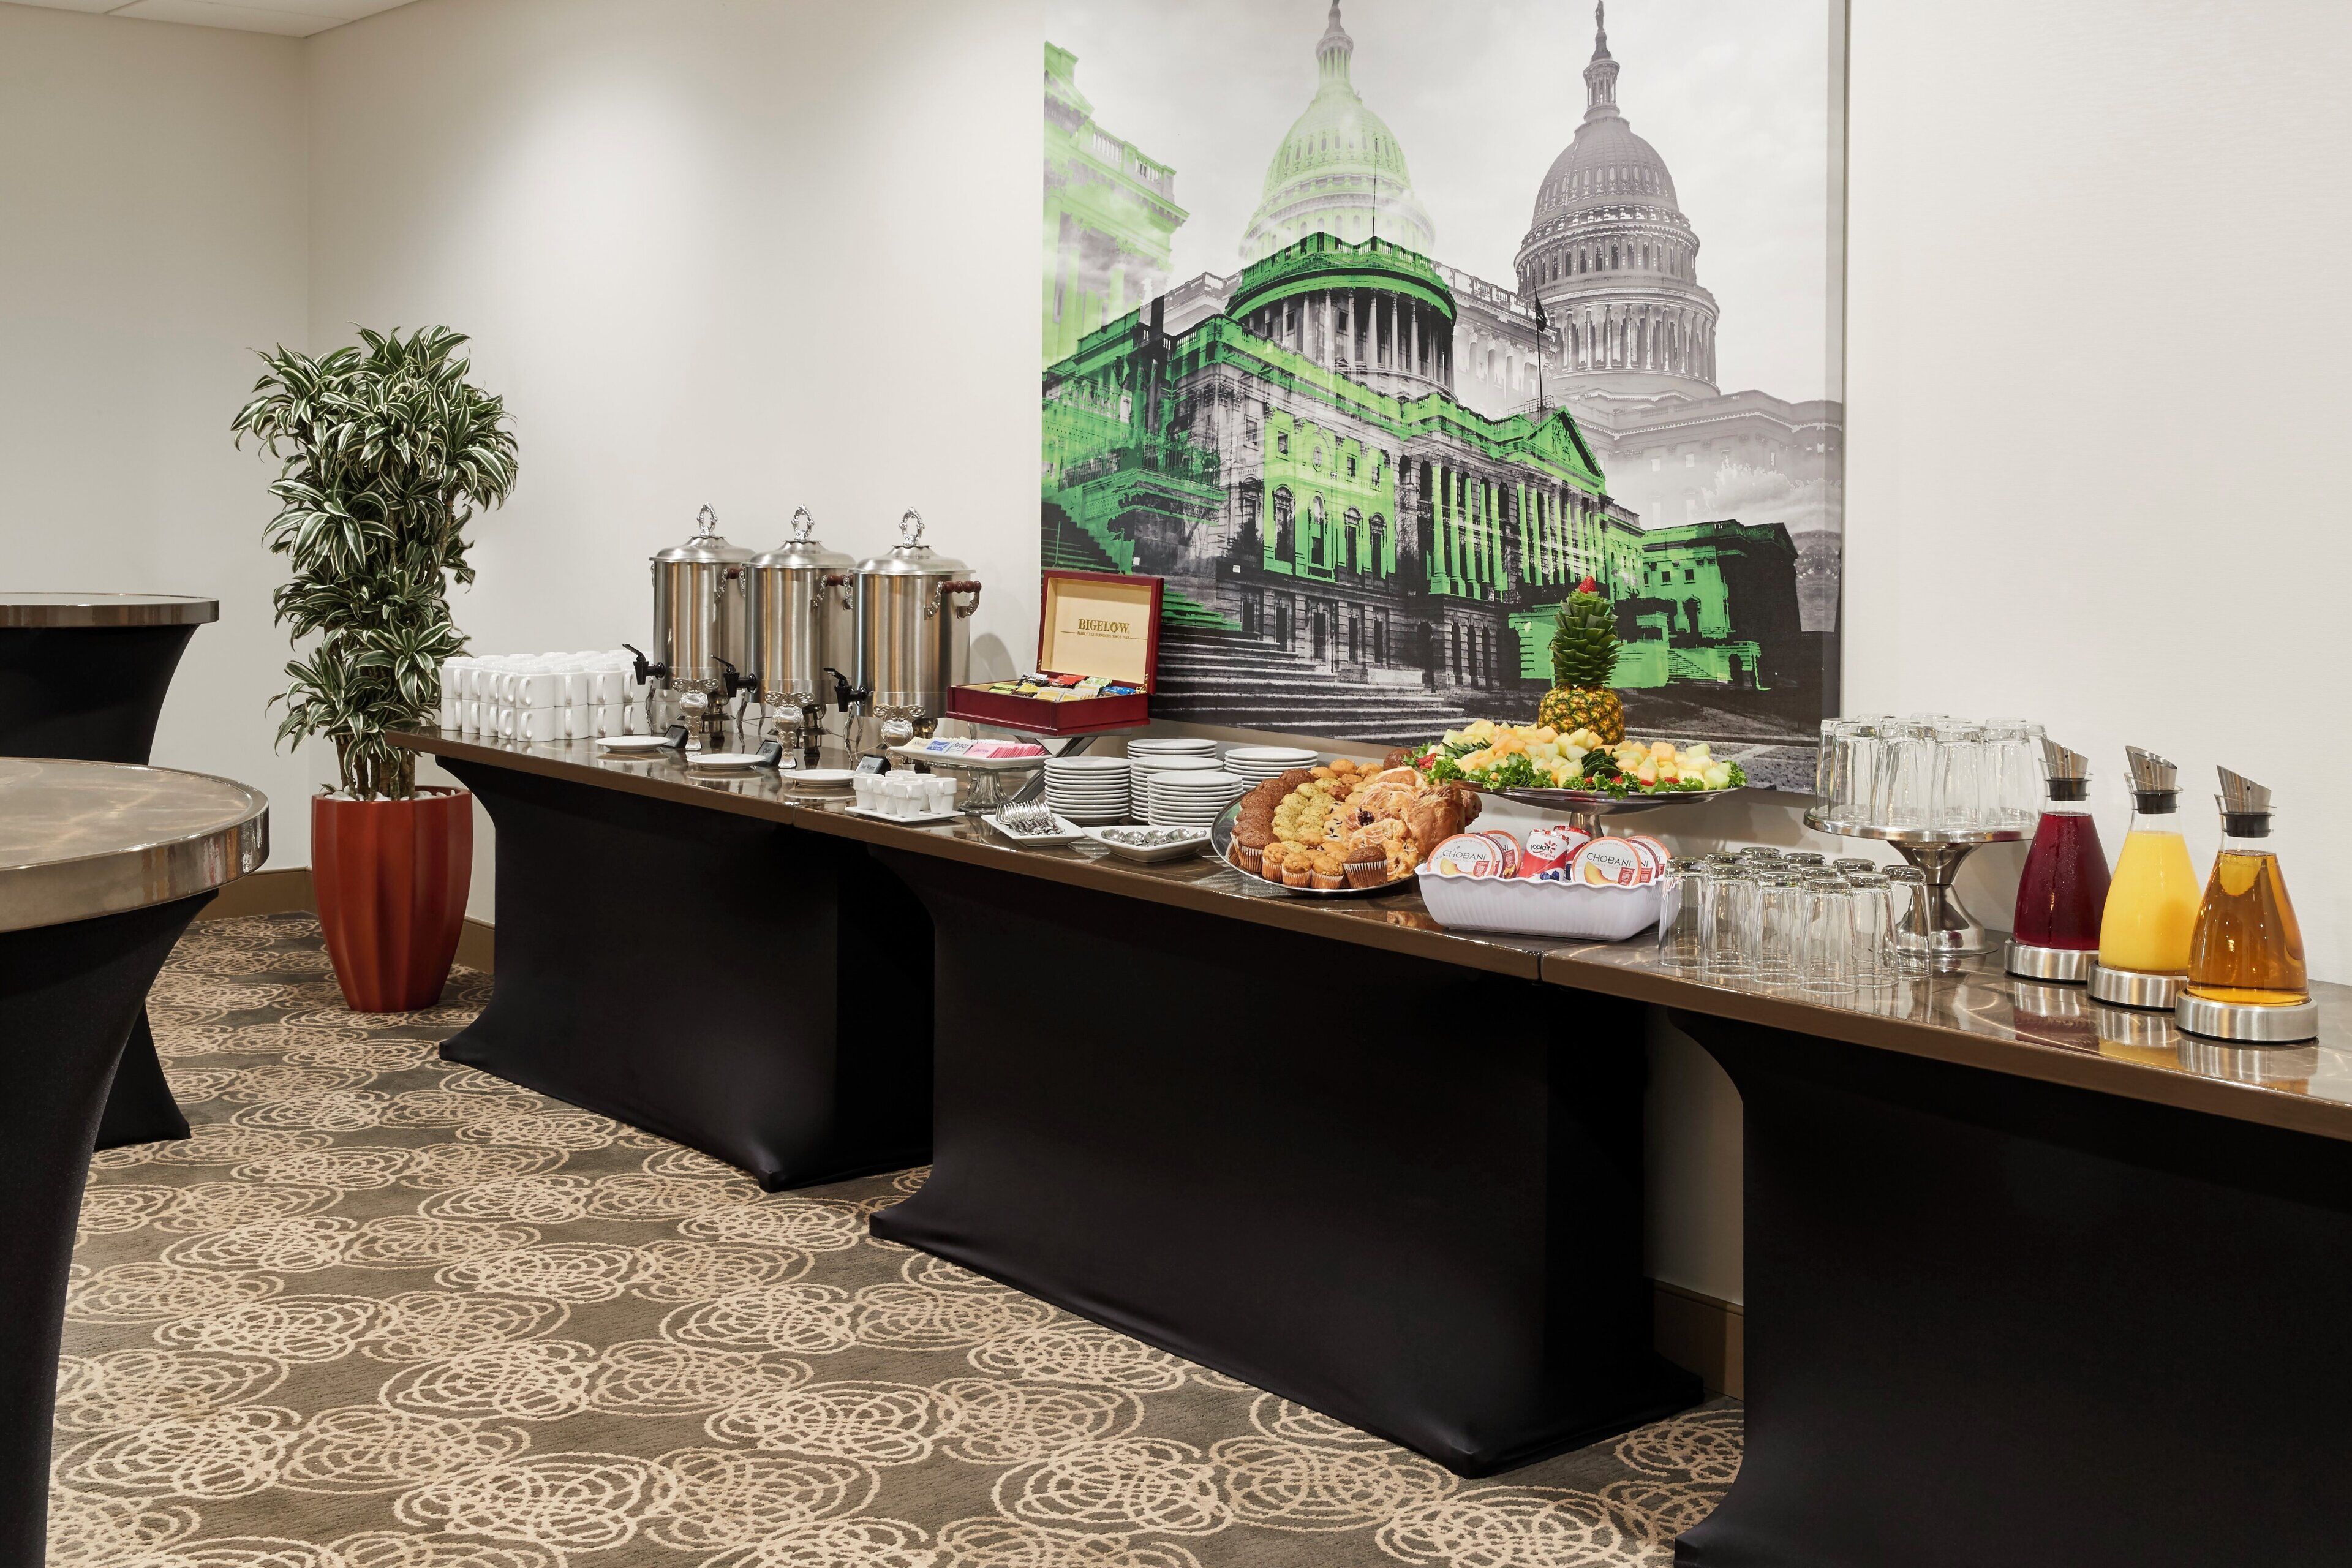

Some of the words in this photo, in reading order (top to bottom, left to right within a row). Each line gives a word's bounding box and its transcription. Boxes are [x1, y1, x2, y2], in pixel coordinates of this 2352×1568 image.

[1078, 619, 1131, 633] BIGELOW
[1442, 850, 1487, 861] CHOBANI
[1586, 853, 1632, 867] CHOBANI
